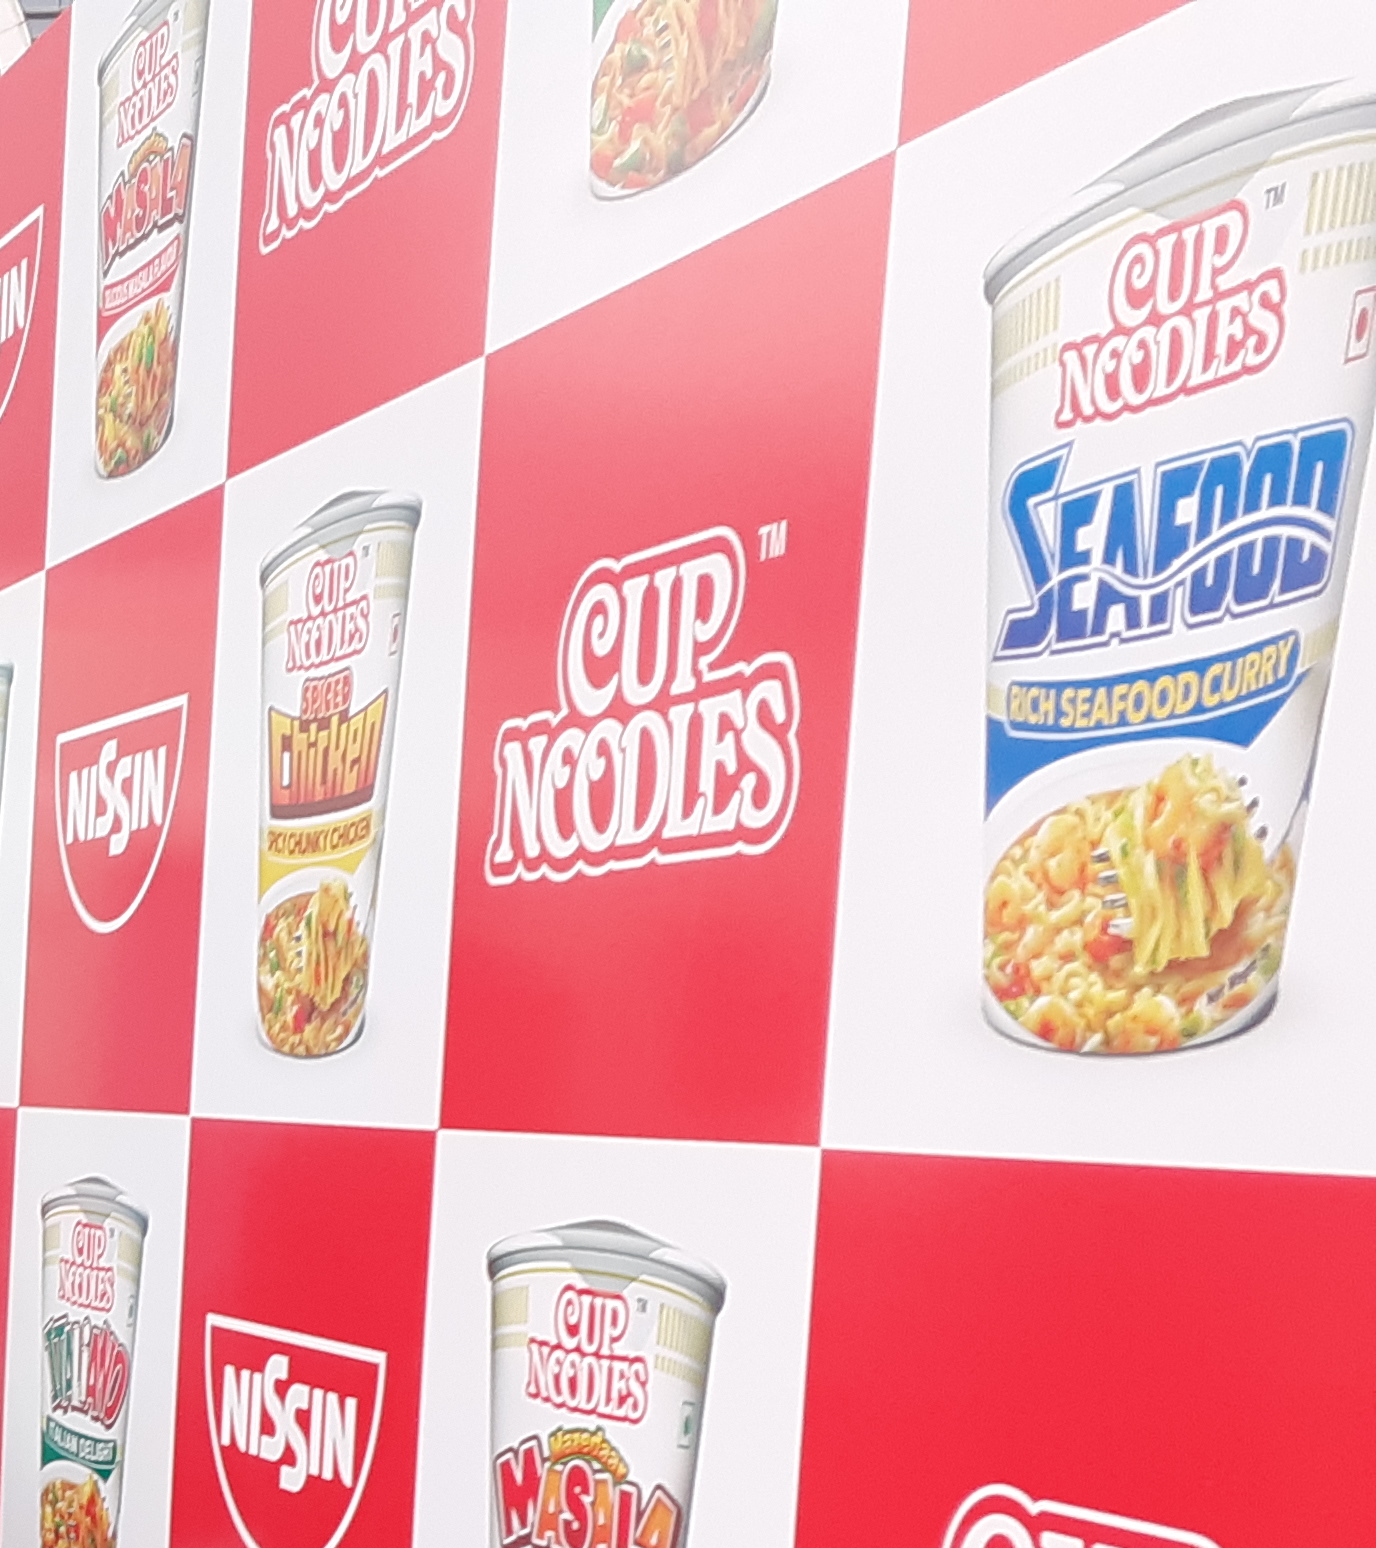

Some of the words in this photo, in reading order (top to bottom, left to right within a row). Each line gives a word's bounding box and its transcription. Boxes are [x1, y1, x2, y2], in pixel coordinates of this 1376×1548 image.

[118, 54, 179, 147] NOODLES
[133, 22, 170, 88] CUP
[265, 0, 466, 236] NOODLES
[101, 134, 193, 276] MASALA
[1109, 200, 1249, 328] CUP
[1055, 267, 1286, 429] NOODLES
[306, 551, 357, 620] CUP
[758, 519, 789, 562] TM
[994, 419, 1355, 660] SEAFOOD
[286, 595, 370, 673] NOODLES
[567, 551, 734, 717] CUP
[1009, 684, 1057, 726] RICH
[1059, 671, 1199, 729] SEAFOOD
[1201, 637, 1295, 709] CURRY
[66, 737, 168, 858] NISSIN
[269, 689, 389, 812] Chicken
[494, 678, 788, 864] NOODLES
[58, 1258, 115, 1312] NOODLES
[72, 1220, 106, 1268] CUP
[554, 1284, 630, 1355] CUP
[220, 1353, 358, 1494] NISSIN
[526, 1336, 649, 1424] NOODLES
